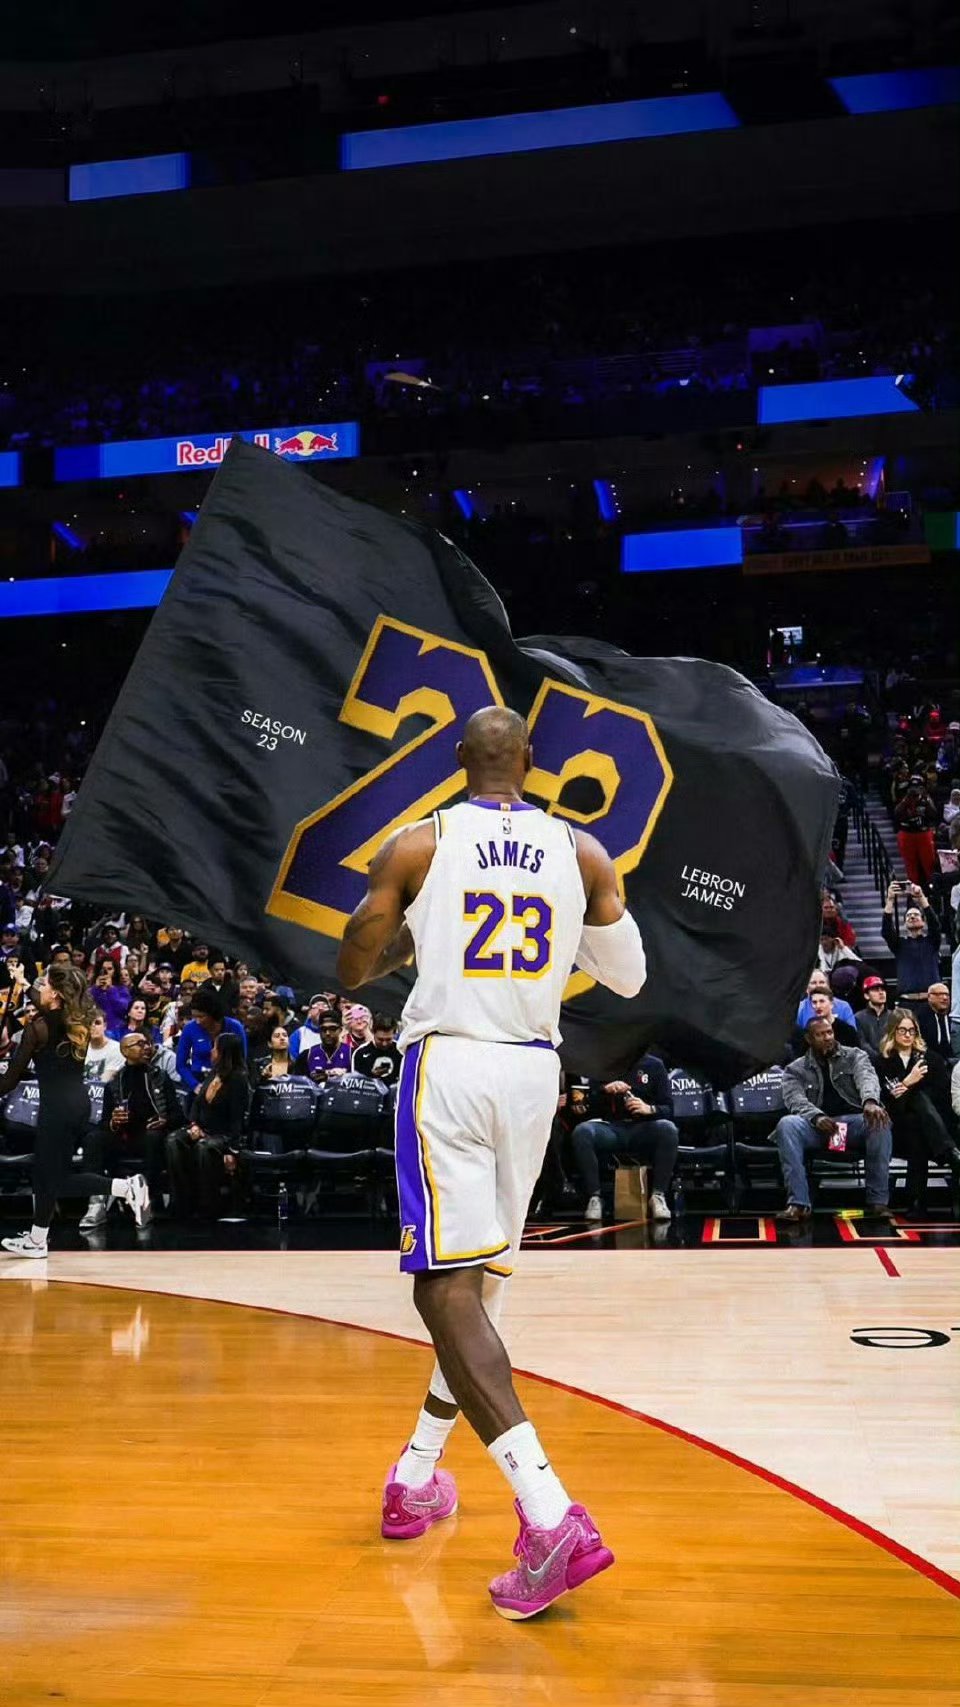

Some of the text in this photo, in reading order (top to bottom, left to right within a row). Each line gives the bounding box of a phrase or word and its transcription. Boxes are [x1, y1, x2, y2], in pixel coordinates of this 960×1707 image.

[177, 438, 223, 466] Red
[241, 709, 307, 746] SEASON
[256, 734, 278, 751] 23
[475, 840, 545, 874] JAMES
[681, 865, 746, 898] LEBRON
[681, 883, 735, 911] JAMES
[463, 890, 555, 980] 23
[87, 1085, 105, 1098] NJ
[269, 1083, 293, 1096] NJM
[341, 1078, 364, 1089] NJM
[671, 1078, 696, 1091] NJM
